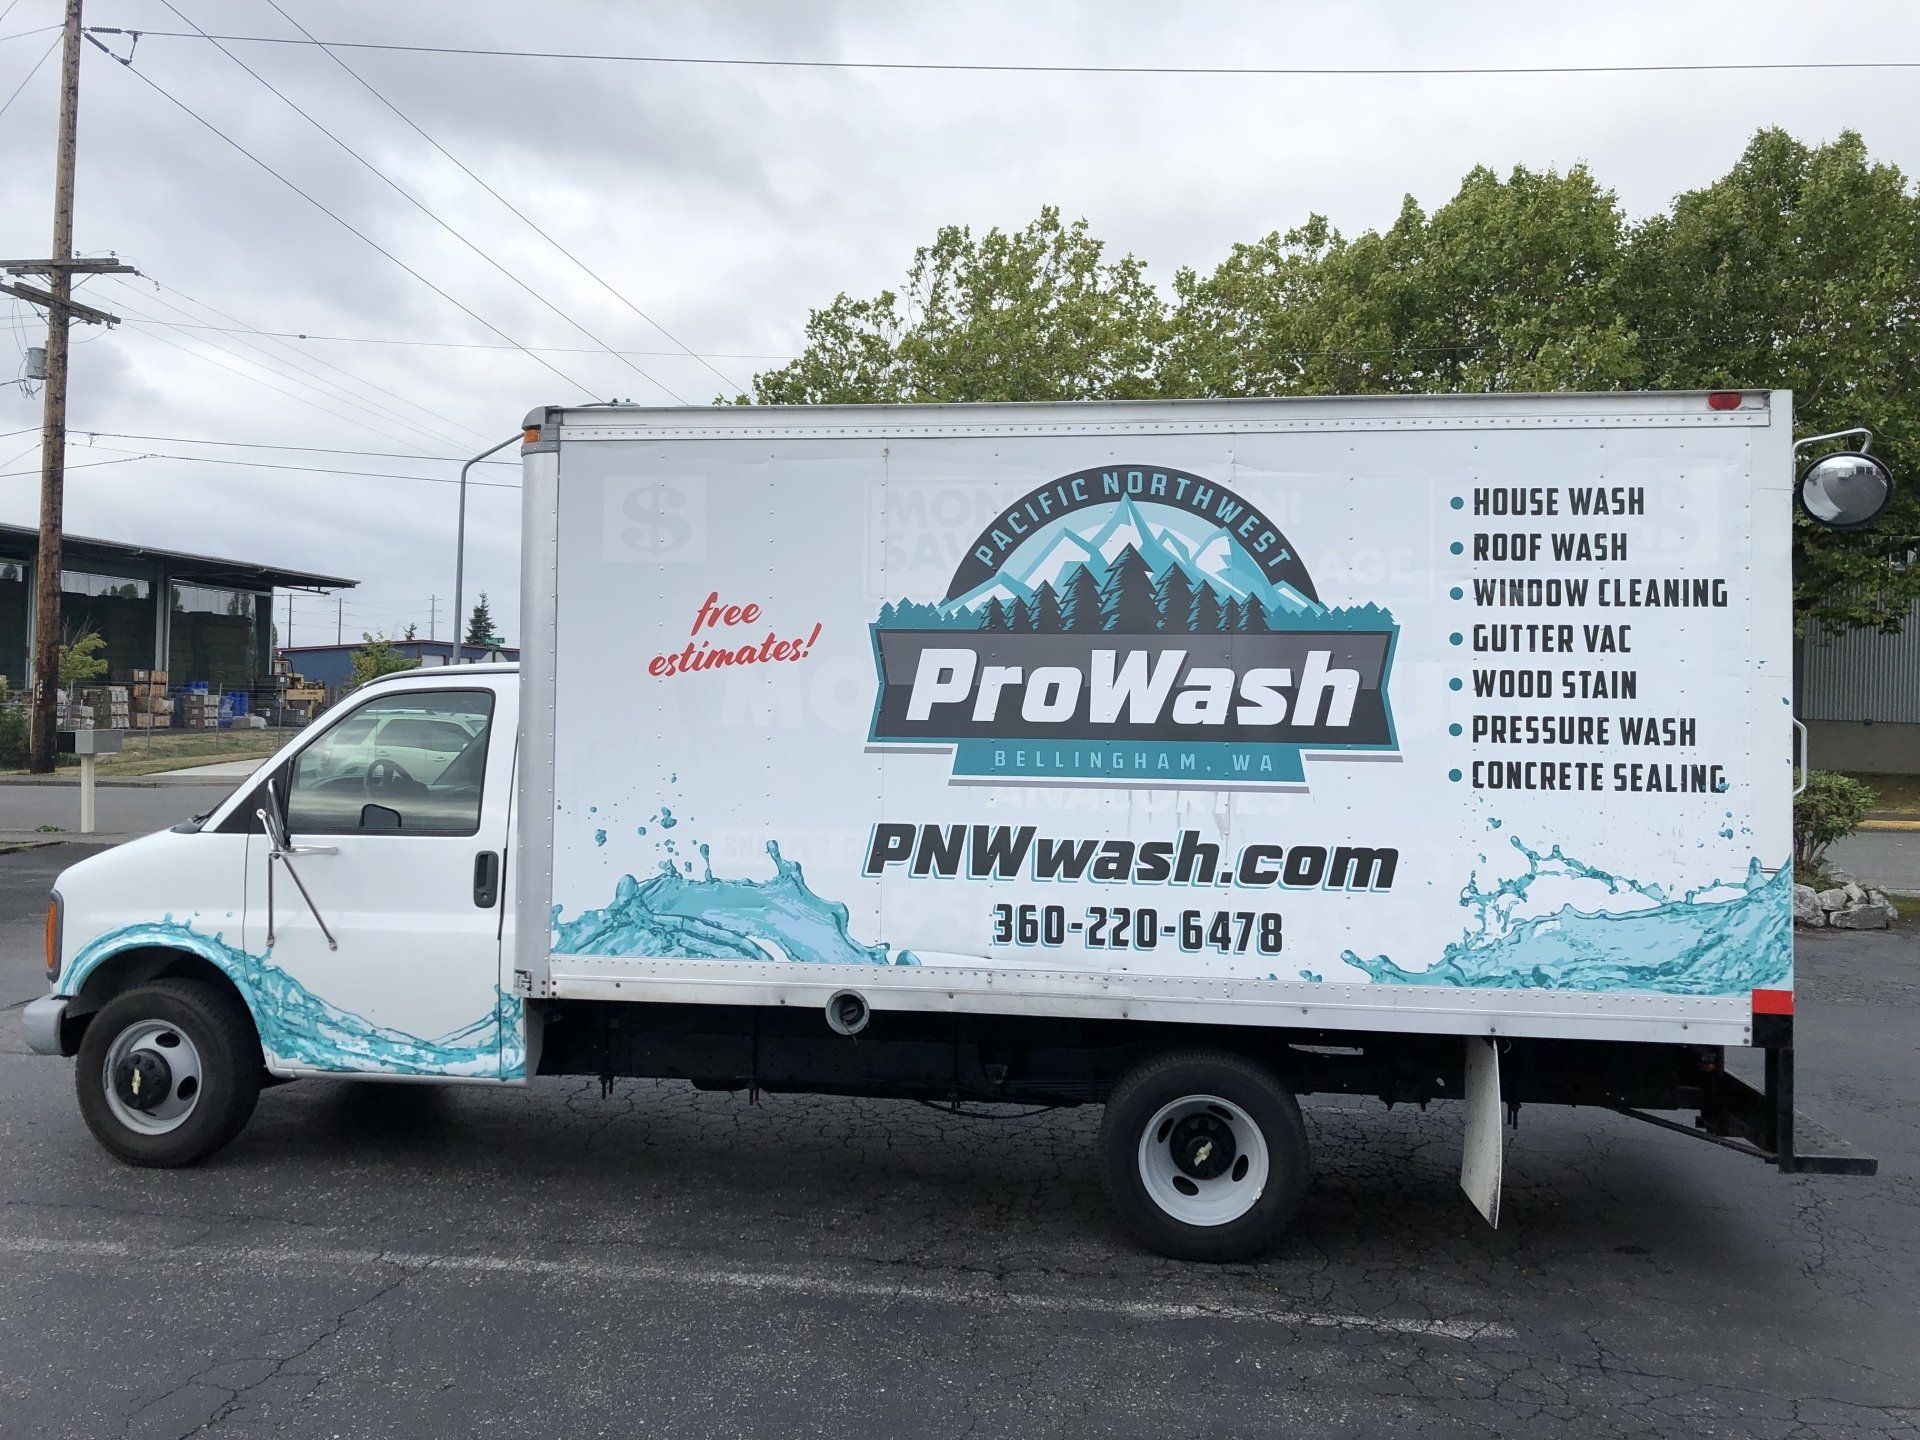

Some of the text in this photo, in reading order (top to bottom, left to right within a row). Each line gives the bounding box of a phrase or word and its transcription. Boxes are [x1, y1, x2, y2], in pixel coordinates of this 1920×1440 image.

[1474, 488, 1643, 515] HOUSE WASH
[974, 470, 1292, 568] PACIFIC NORTHWEST
[1474, 533, 1626, 561] ROOF WASH
[1473, 579, 1727, 607] WINDOW CLEANING
[692, 592, 761, 637] free
[648, 624, 821, 676] estimates!
[1474, 624, 1631, 652] GUTTER VAC
[906, 649, 1359, 726] ProWash
[1473, 670, 1636, 699] WOOD STAIN
[1473, 716, 1695, 746] PRESSURE WASH
[994, 750, 1273, 773] BELLINGHAM, WA
[1473, 761, 1728, 793] CONCRETE SEALING
[864, 823, 1399, 890] PNWwash.com
[996, 904, 1282, 952] 360-220-6478
